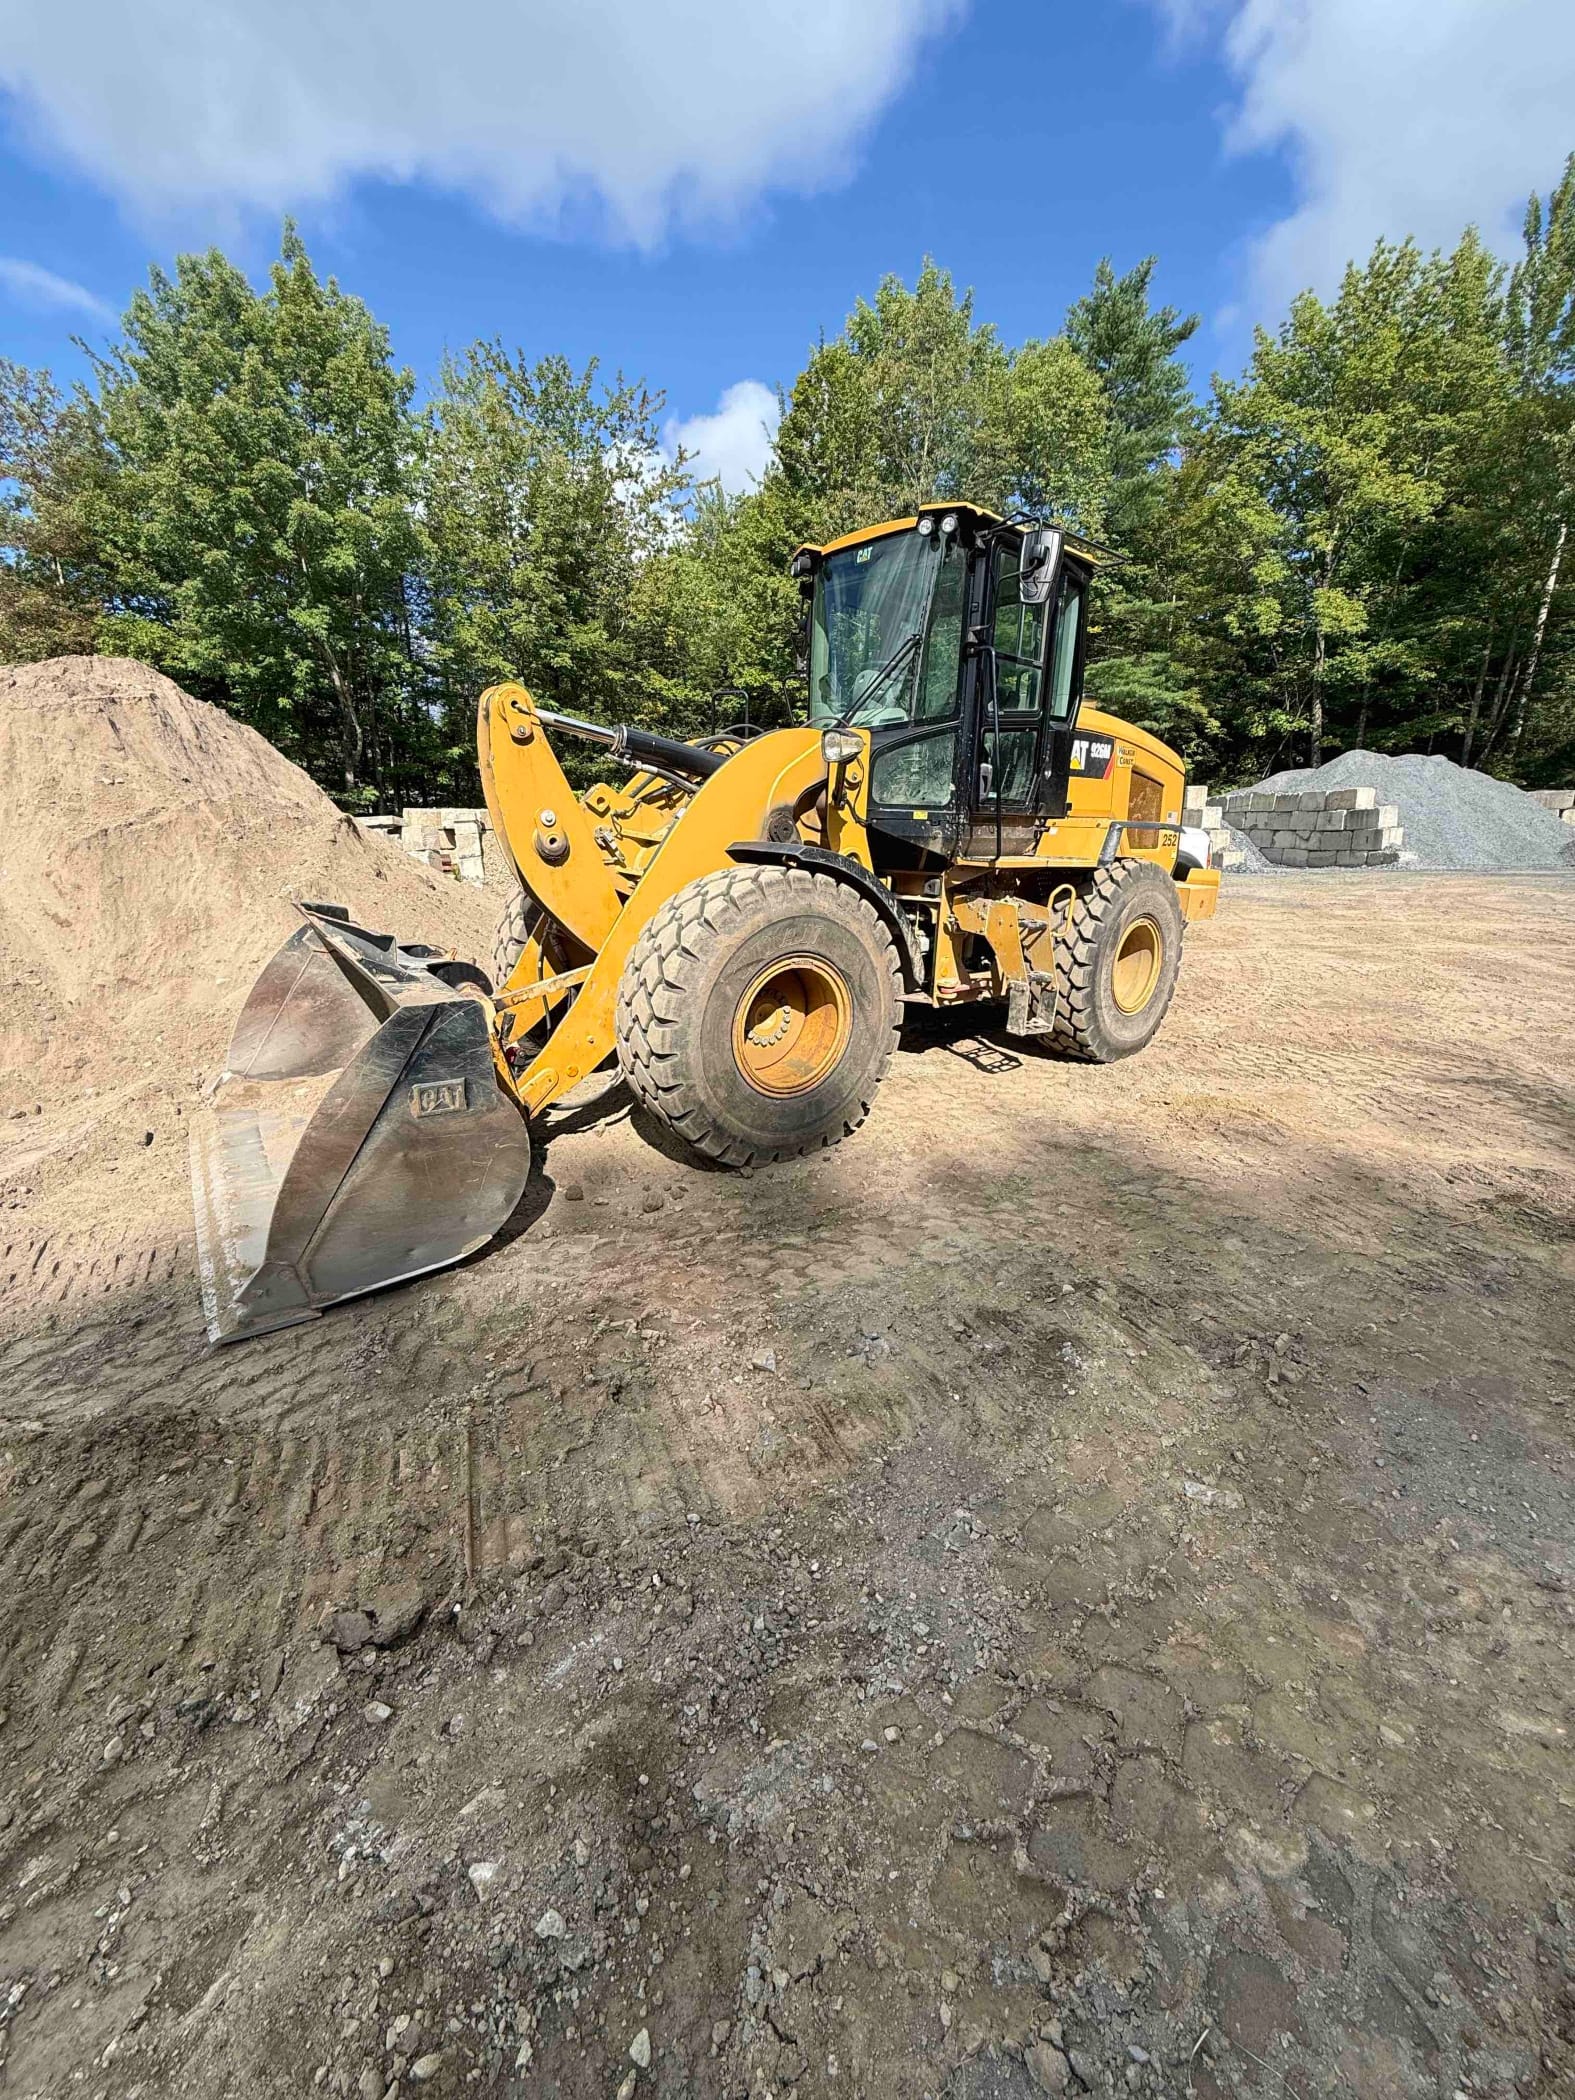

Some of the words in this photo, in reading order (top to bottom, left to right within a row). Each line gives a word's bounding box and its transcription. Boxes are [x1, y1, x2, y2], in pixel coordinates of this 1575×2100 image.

[857, 546, 873, 564] CAT
[1070, 739, 1089, 770] AT
[1162, 833, 1177, 847] 252
[421, 1084, 464, 1113] CAT
